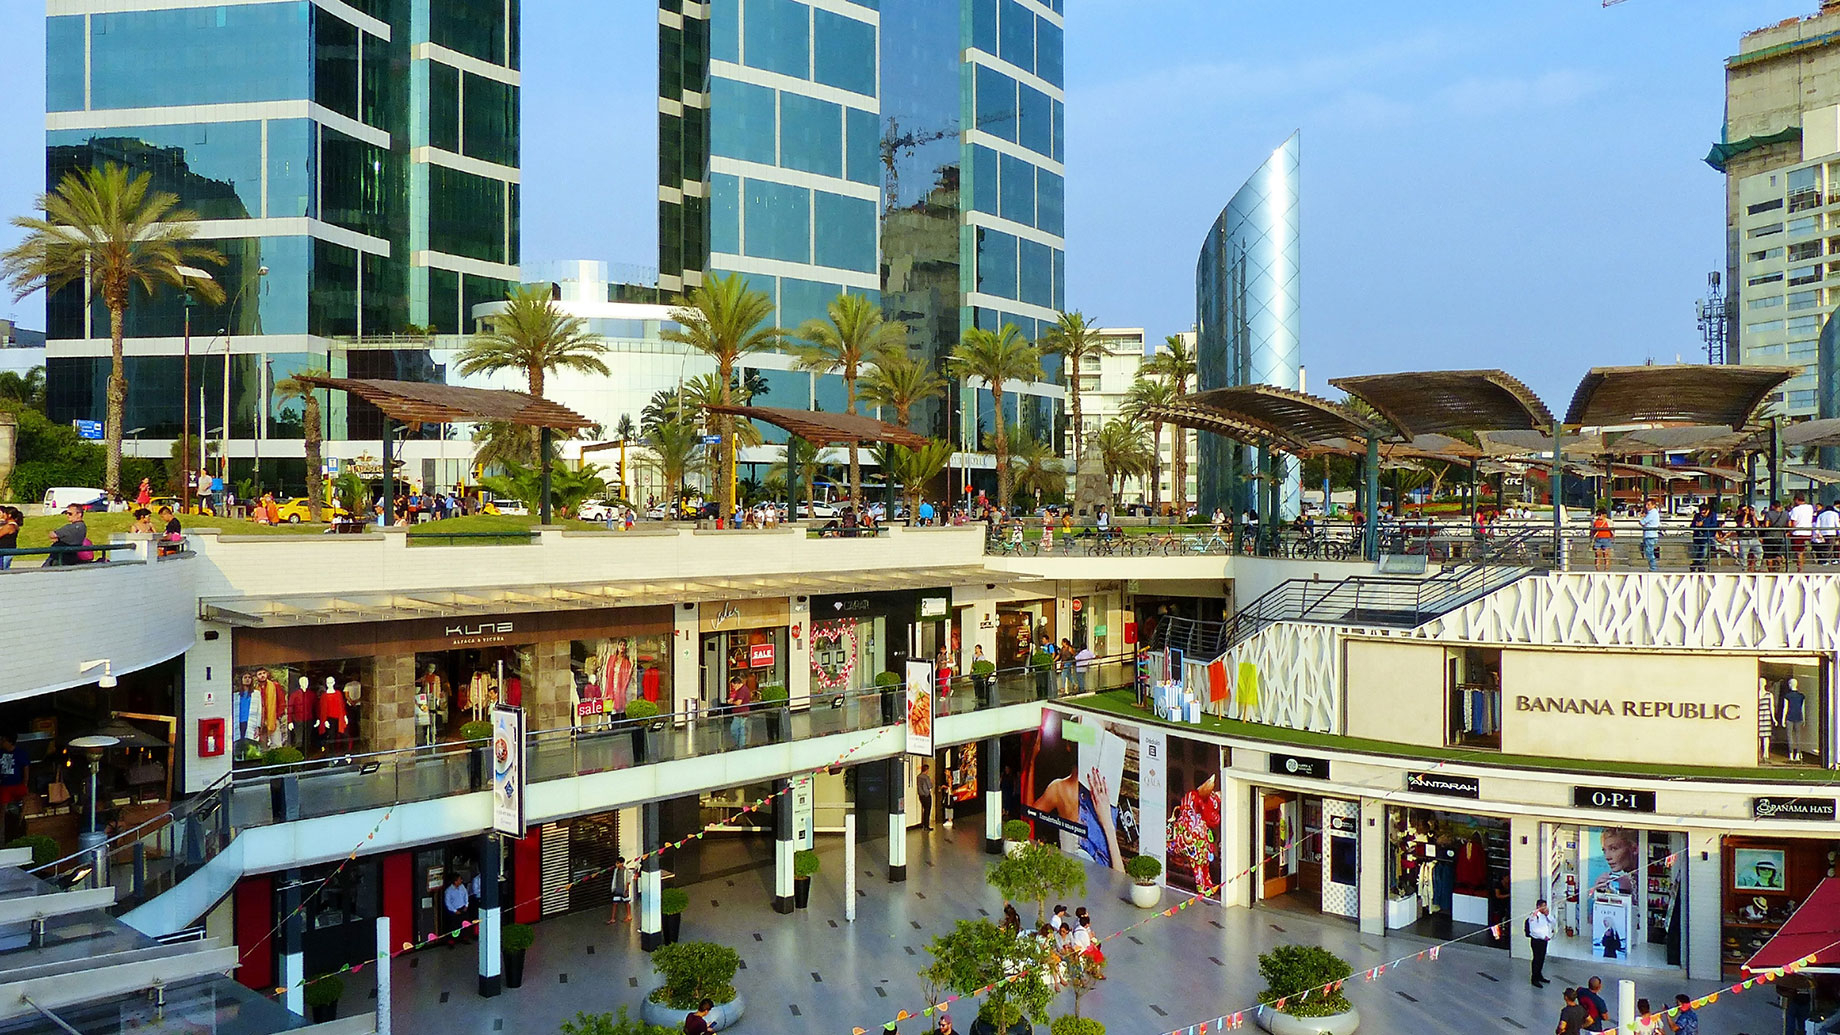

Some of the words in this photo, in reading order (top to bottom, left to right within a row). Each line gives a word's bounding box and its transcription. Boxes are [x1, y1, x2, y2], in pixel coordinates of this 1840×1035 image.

[1504, 477, 1522, 485] KFC
[753, 649, 772, 659] SALE
[579, 699, 603, 716] sale
[1516, 695, 1615, 716] BANANA
[1622, 701, 1741, 721] REPUBLIC
[1410, 779, 1477, 792] ANNTARAH
[1771, 803, 1808, 813] PANAMA
[1810, 805, 1833, 814] HATS
